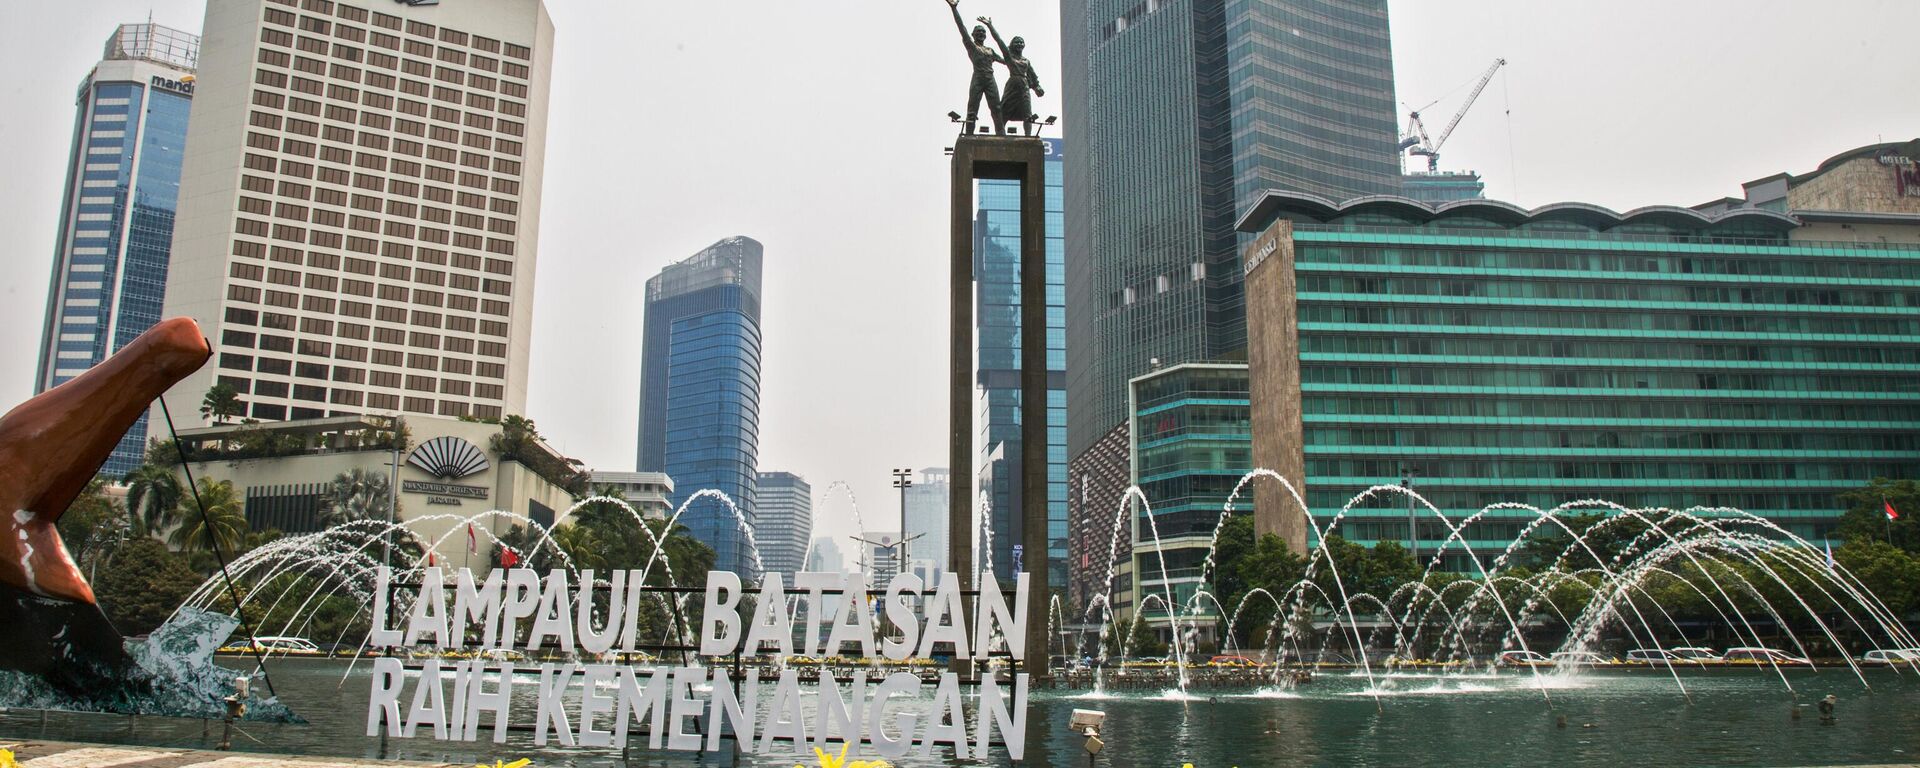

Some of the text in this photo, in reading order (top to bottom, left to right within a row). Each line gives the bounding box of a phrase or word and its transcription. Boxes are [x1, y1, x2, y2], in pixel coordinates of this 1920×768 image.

[403, 481, 489, 498] MANDARIN ORIENTAL
[370, 566, 1031, 661] LAMPAUI BATASAN
[366, 657, 1030, 761] RAIH KEMENANGAN
